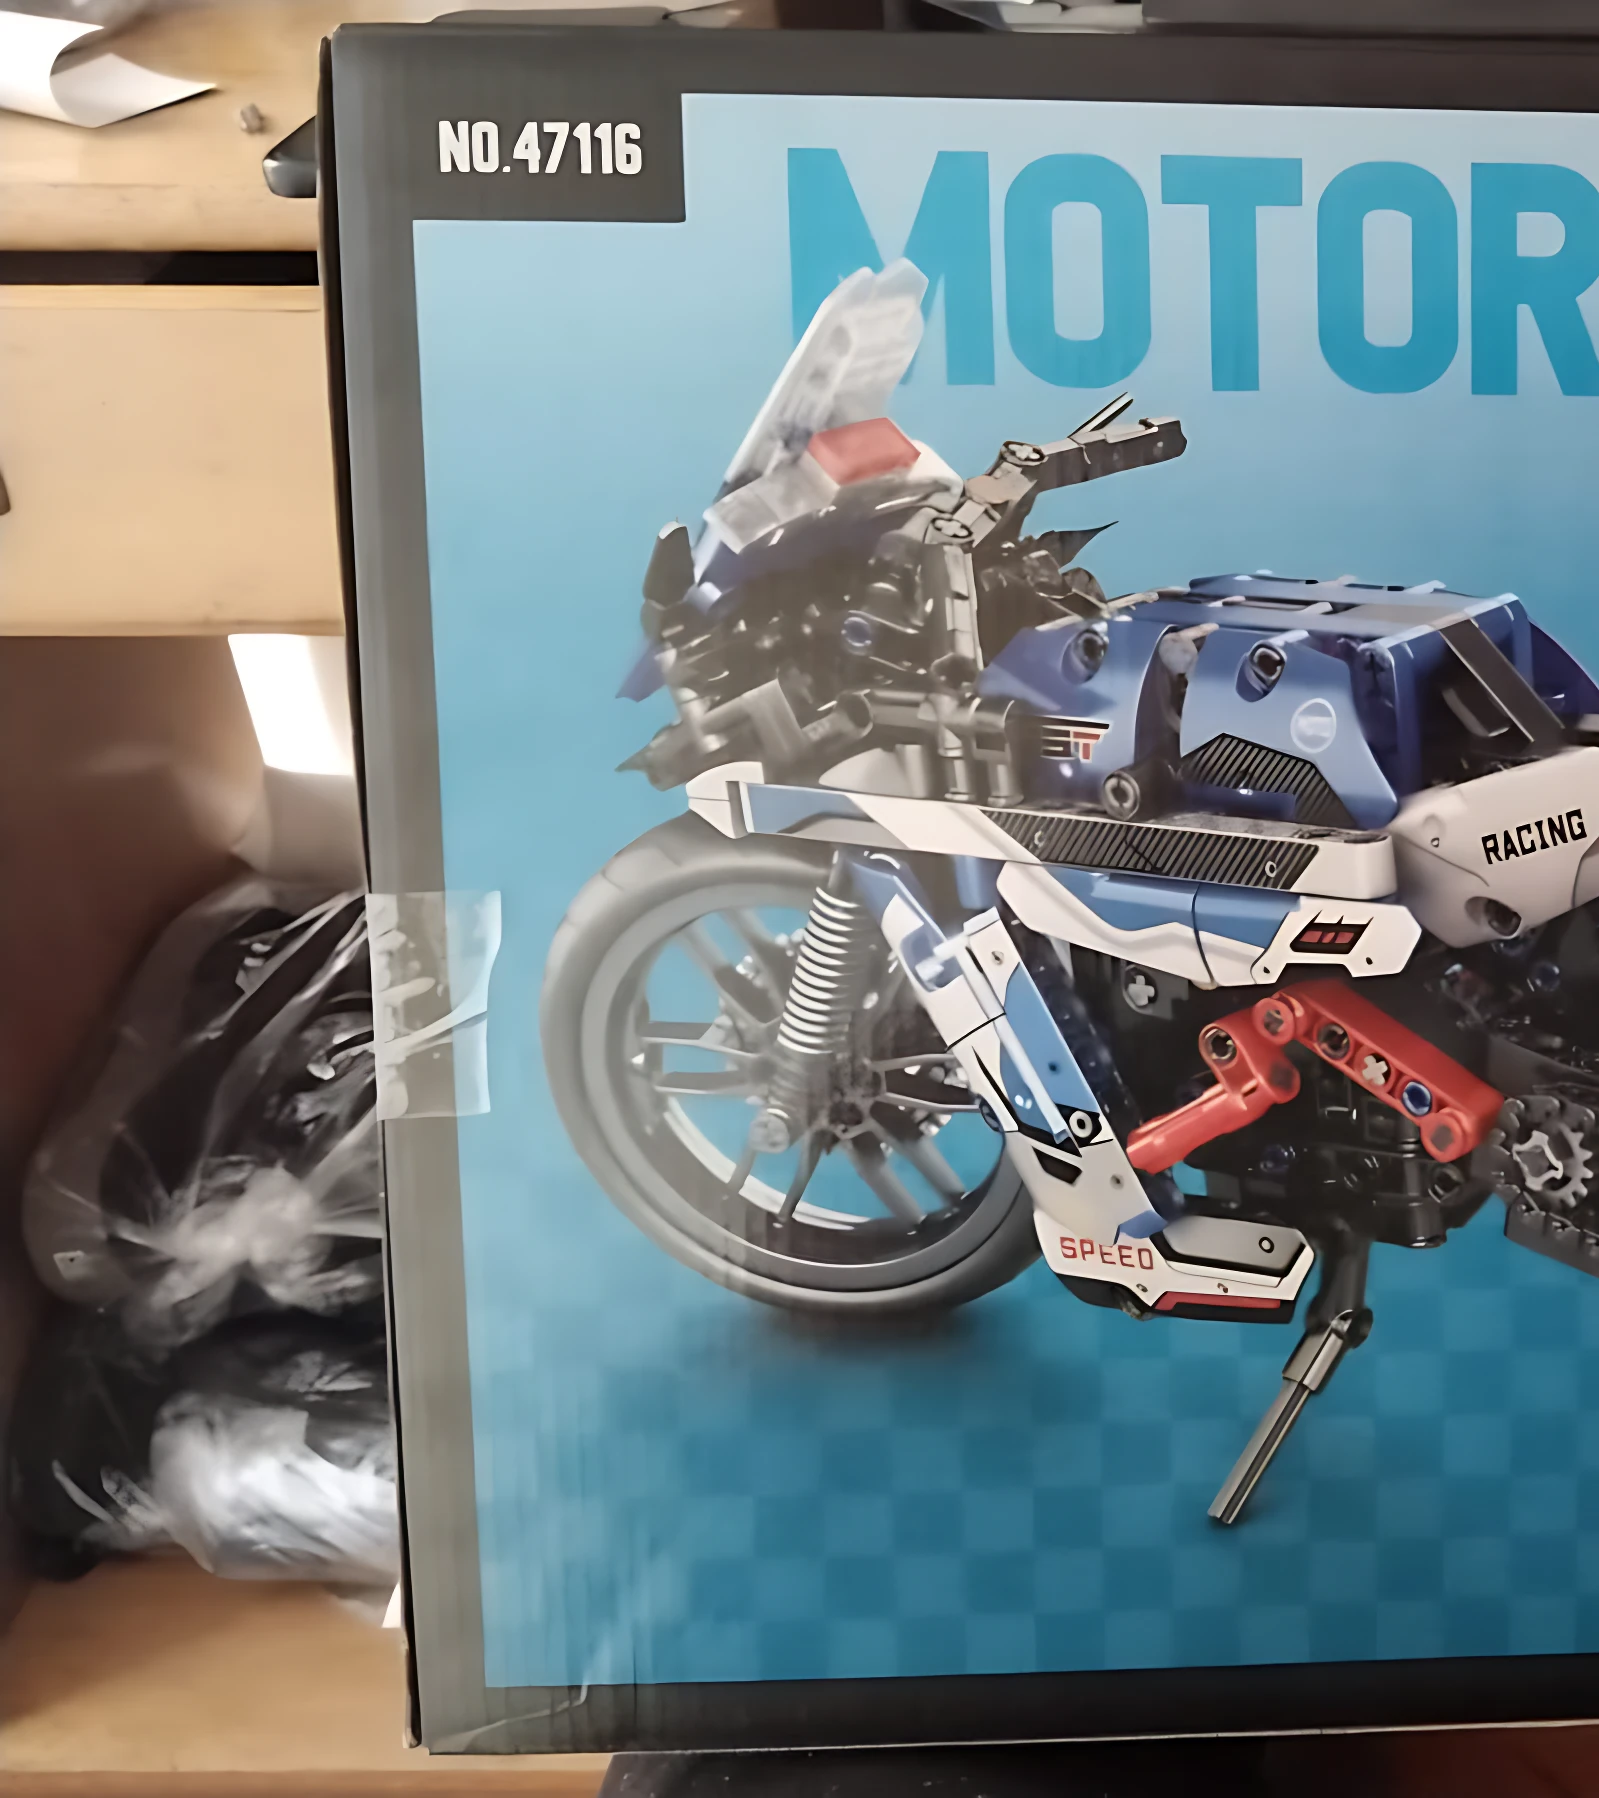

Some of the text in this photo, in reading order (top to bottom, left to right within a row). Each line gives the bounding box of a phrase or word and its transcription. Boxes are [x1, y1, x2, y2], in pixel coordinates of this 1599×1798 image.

[438, 120, 642, 174] NO.47116
[1481, 808, 1588, 865] RACING
[1059, 1236, 1155, 1270] SPEED
